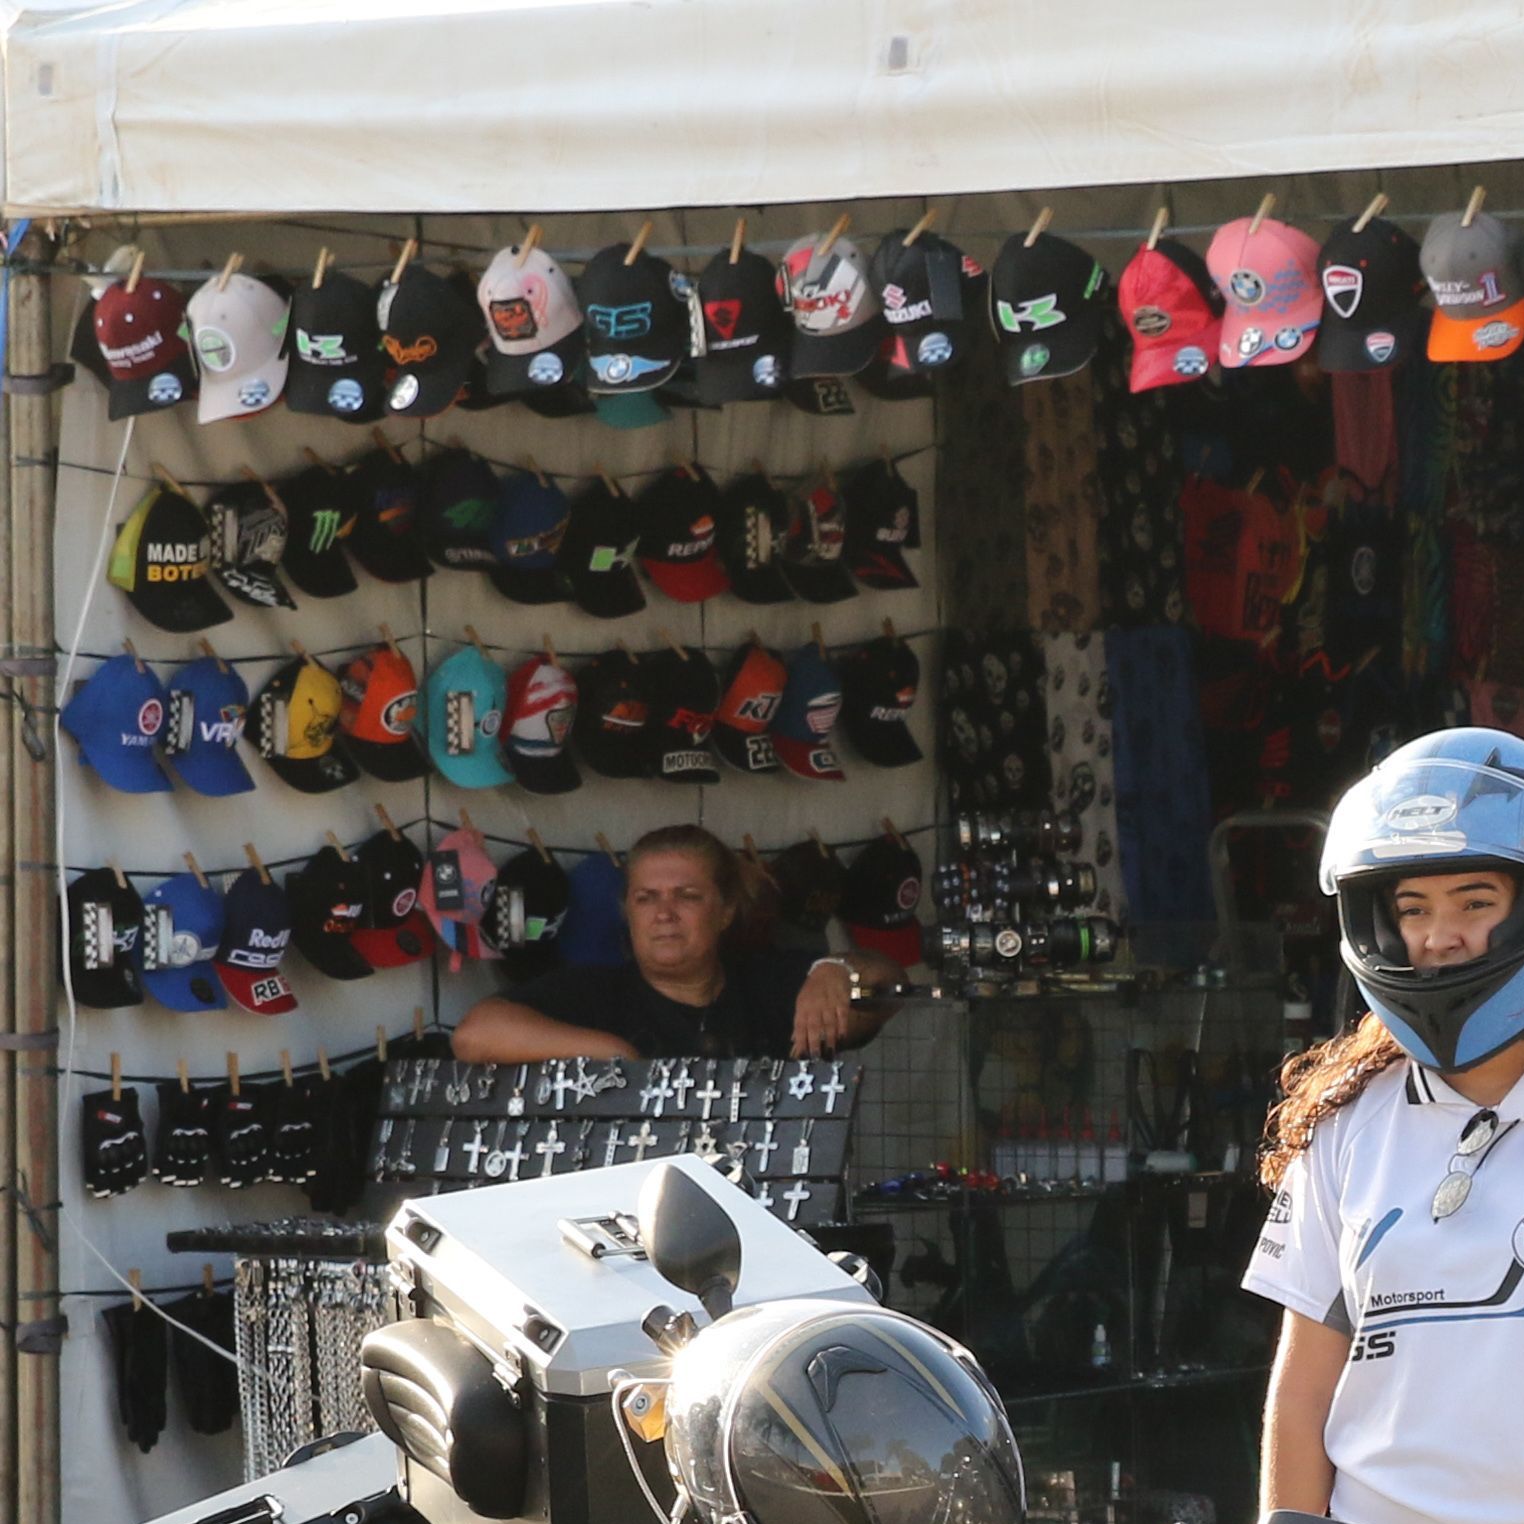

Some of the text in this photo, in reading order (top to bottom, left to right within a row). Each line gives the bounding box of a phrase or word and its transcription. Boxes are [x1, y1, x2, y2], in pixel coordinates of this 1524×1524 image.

[147, 542, 197, 563] MADE
[1392, 805, 1448, 821] HELT
[1370, 1289, 1445, 1307] Motorsport
